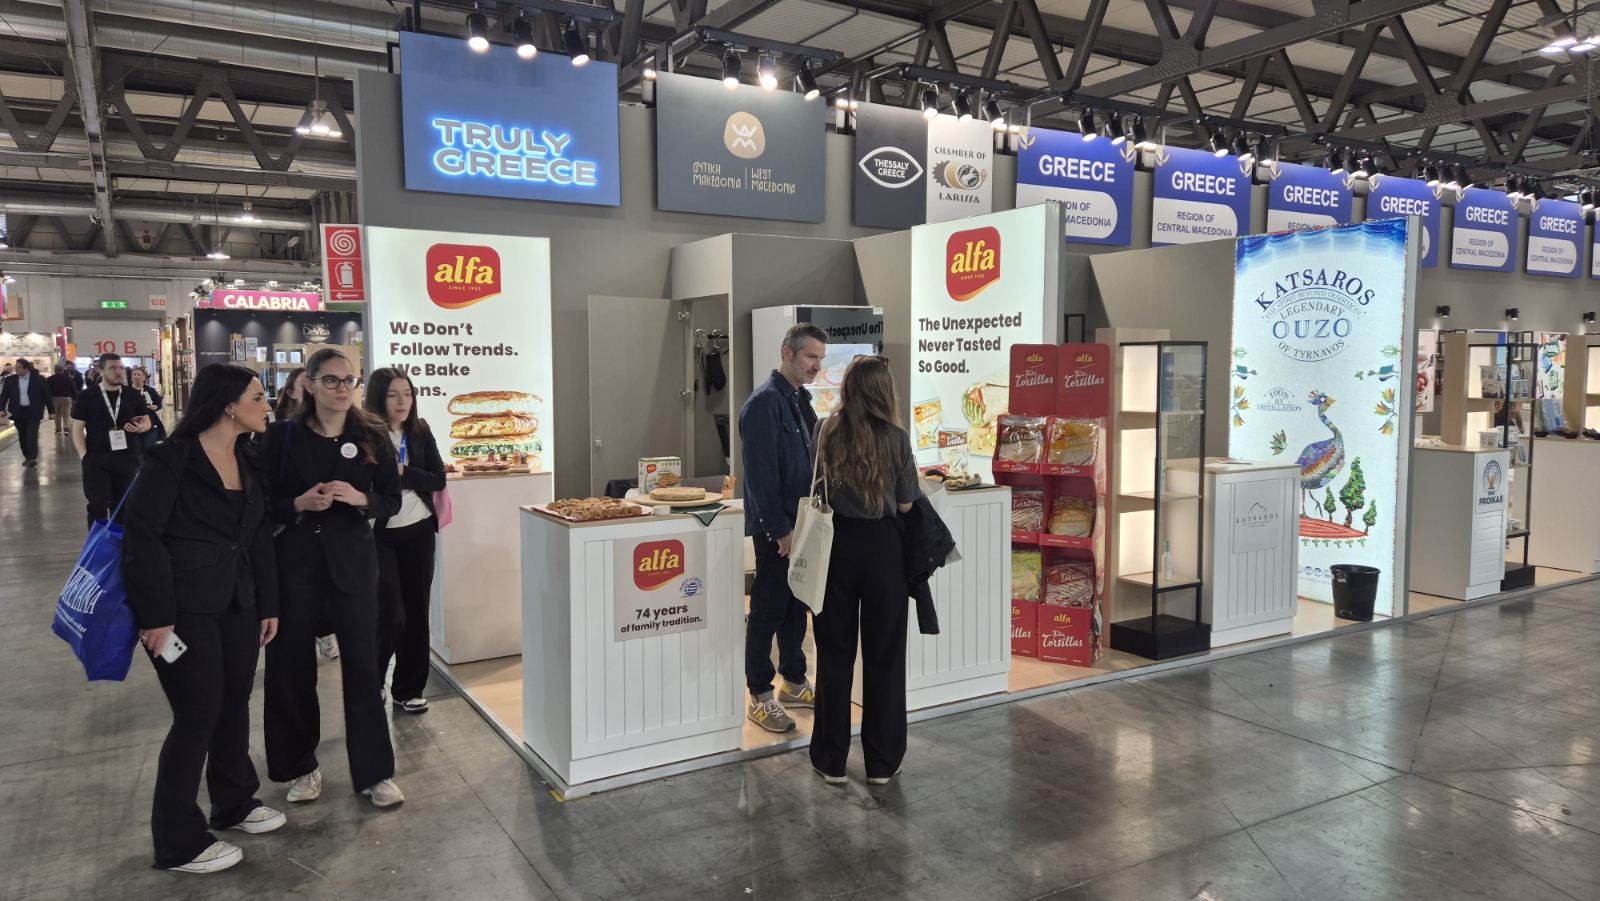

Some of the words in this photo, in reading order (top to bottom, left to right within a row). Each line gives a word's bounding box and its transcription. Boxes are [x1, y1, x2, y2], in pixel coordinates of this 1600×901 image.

[432, 118, 570, 156] TRULY
[934, 146, 974, 158] CHAMBER
[976, 151, 987, 160] OF
[433, 147, 597, 186] GREECE
[874, 158, 909, 171] THESSALY
[1039, 154, 1116, 184] GREECE
[751, 167, 772, 179] WEST
[878, 167, 906, 178] GREECE
[751, 179, 797, 194] MACEDONIA
[1171, 170, 1237, 197] GREECE
[938, 192, 981, 204] LARISSA
[1283, 184, 1339, 208] GREECE
[1079, 202, 1091, 212] OF
[1381, 195, 1430, 217] GREECE
[1177, 211, 1204, 222] REGION
[1205, 214, 1217, 223] OF
[1466, 206, 1509, 226] GREECE
[1157, 222, 1190, 234] CENTRAL
[1191, 225, 1233, 237] MACEDONIA
[1539, 215, 1577, 235] GREECE
[1468, 238, 1487, 246] REGION
[950, 239, 995, 275] alfa
[1455, 247, 1477, 256] CENTRAL
[1478, 249, 1505, 258] MACEDONIA
[433, 255, 494, 285] alfa
[1255, 268, 1376, 312] KATSAROS
[149, 298, 166, 306] 10B
[223, 295, 310, 310] CALABRIA
[1280, 301, 1345, 320] LEGENDARY
[389, 321, 420, 336] We
[423, 321, 473, 336] Don’t
[918, 317, 941, 332] The
[942, 311, 1023, 335] Unexpected
[1272, 318, 1352, 339] OUZO
[303, 327, 330, 336] DeVita
[94, 341, 116, 354] 10
[124, 341, 137, 354] B
[390, 341, 450, 356] Follow
[453, 342, 519, 357] Trends.
[918, 338, 954, 353] Never
[956, 336, 1001, 352] Tasted
[1278, 341, 1292, 353] OF
[1294, 339, 1345, 360] TYRNAVOS
[1026, 353, 1043, 362] alfa
[1075, 353, 1093, 362] alfa
[424, 363, 471, 377] Bake
[918, 359, 933, 374] So
[934, 359, 970, 374] Good.
[1015, 373, 1054, 388] Tortillas
[1064, 374, 1105, 389] Tortillas
[1478, 495, 1504, 506] PROIKAS
[638, 548, 680, 572] alfa
[636, 608, 651, 620] 74
[653, 605, 689, 621] years
[1053, 613, 1072, 623] alfa
[620, 624, 630, 633] of
[631, 620, 660, 631] family
[662, 615, 703, 628] tradition.
[1042, 633, 1083, 648] Tortillas
